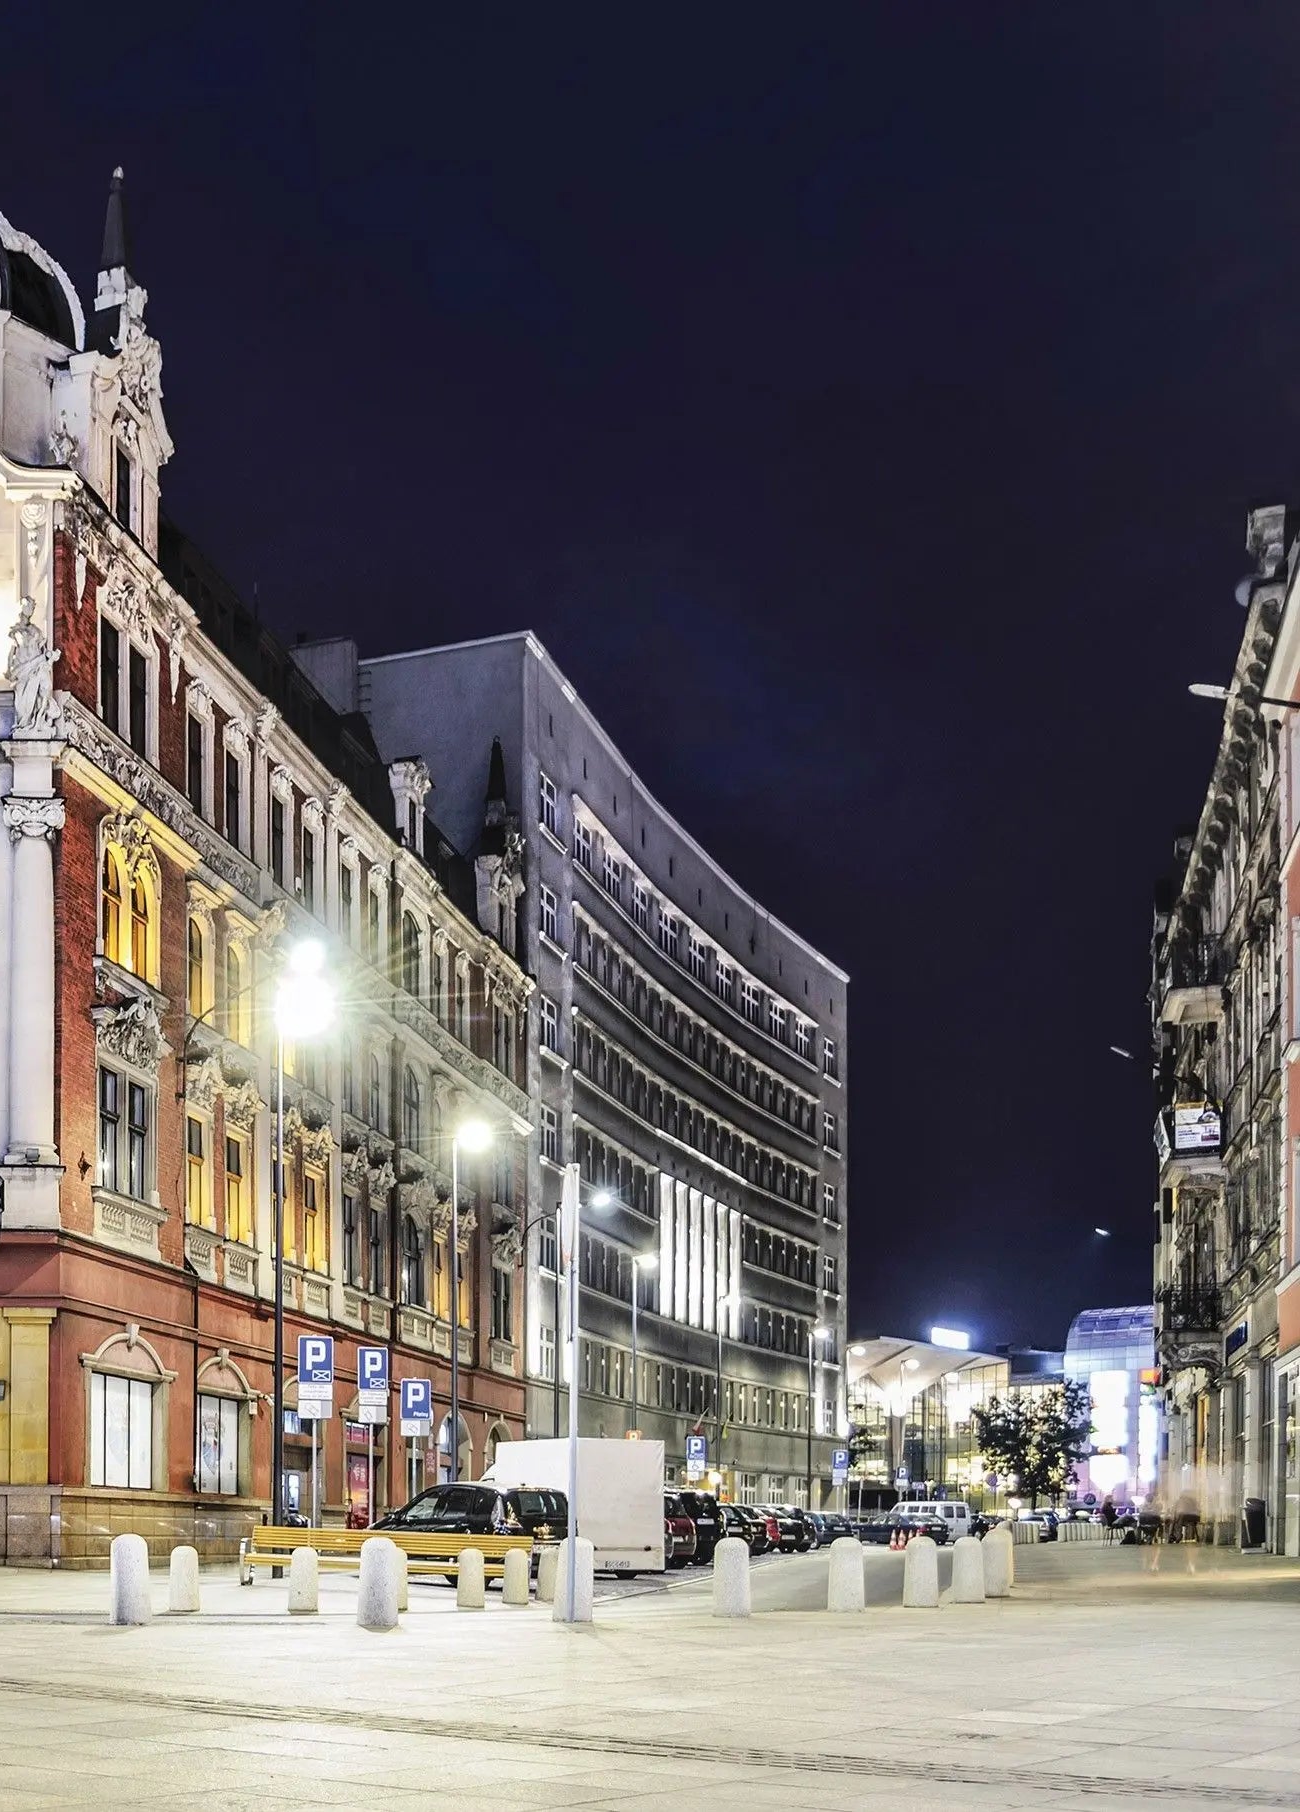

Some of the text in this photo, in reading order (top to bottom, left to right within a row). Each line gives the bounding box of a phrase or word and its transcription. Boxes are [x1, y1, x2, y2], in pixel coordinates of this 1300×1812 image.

[305, 1340, 327, 1371] P
[364, 1351, 383, 1379] P
[407, 1382, 425, 1409] P
[690, 1439, 702, 1454] P
[835, 1452, 846, 1464] P
[899, 1467, 907, 1478] P
